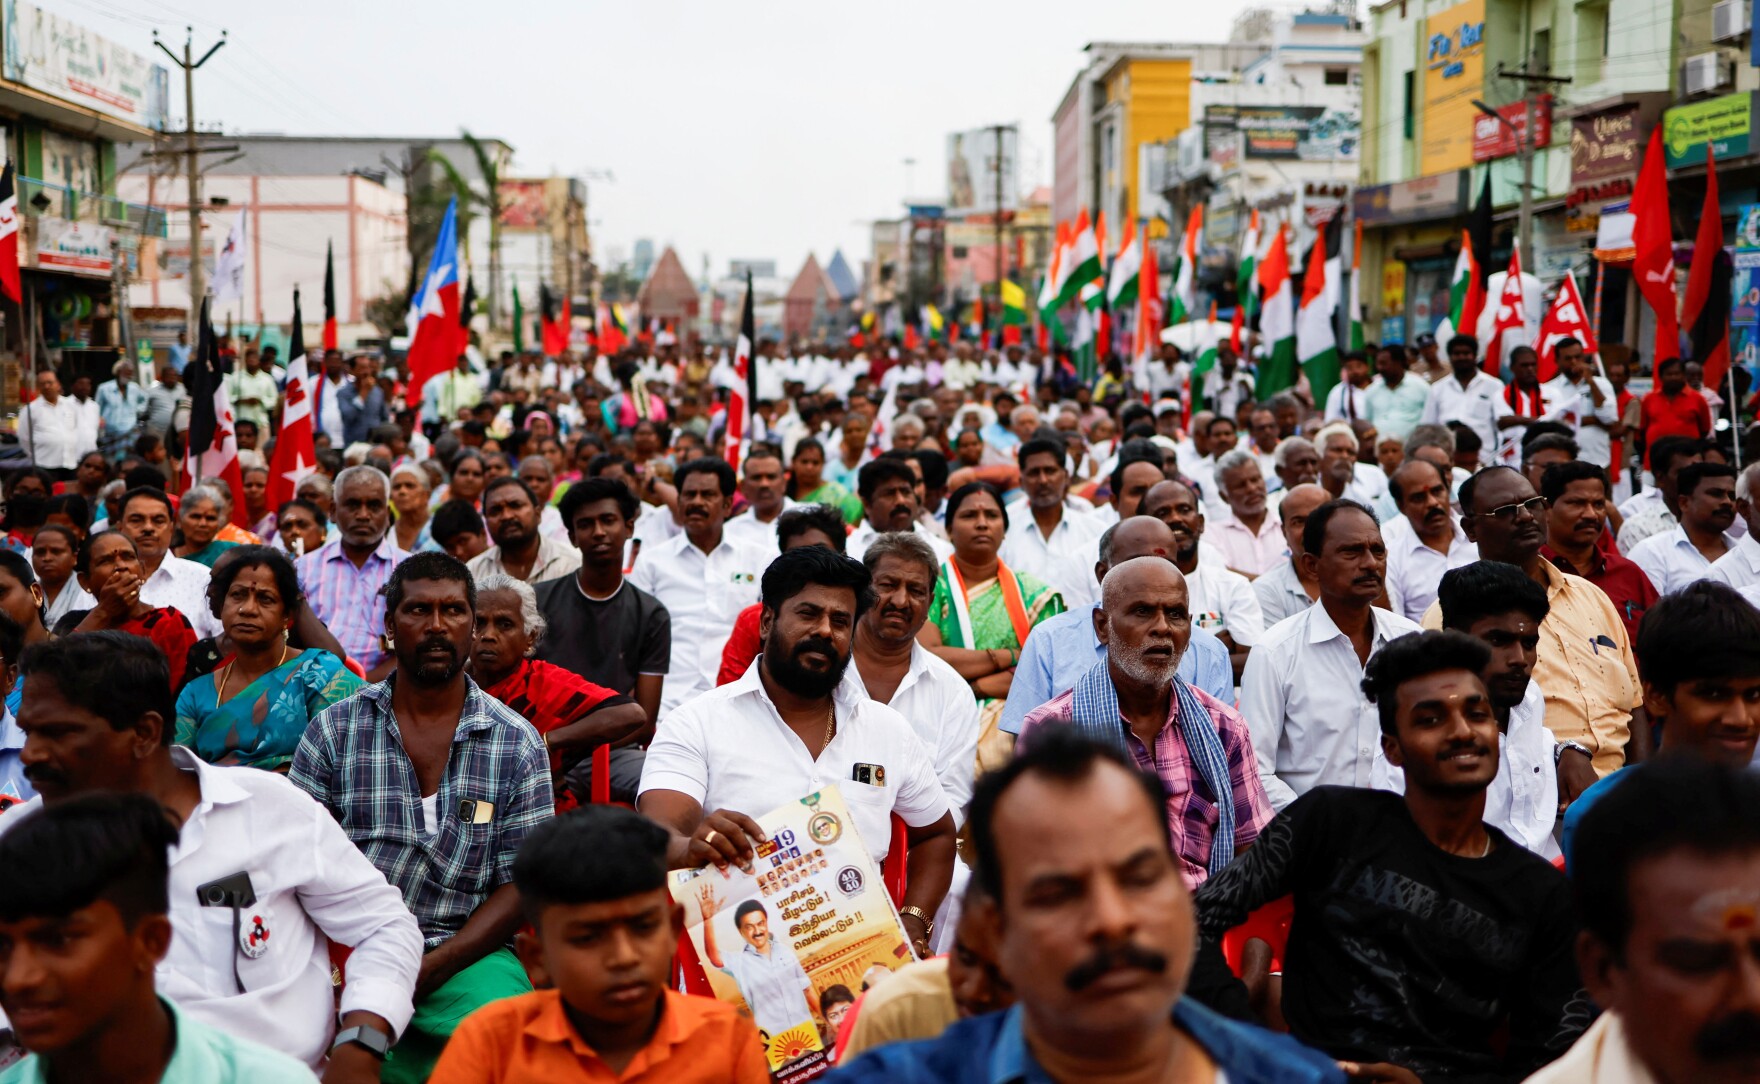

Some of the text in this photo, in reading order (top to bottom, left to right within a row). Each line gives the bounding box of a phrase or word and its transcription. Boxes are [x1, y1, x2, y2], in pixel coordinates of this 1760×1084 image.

[773, 829, 795, 850] 19
[841, 870, 856, 881] 40
[846, 880, 859, 891] 40
[776, 883, 815, 909] பாசிசம்
[781, 893, 824, 920] வீழட்டும்
[789, 908, 836, 937] இந்தியா
[794, 915, 854, 950] வெல்லட்டும்
